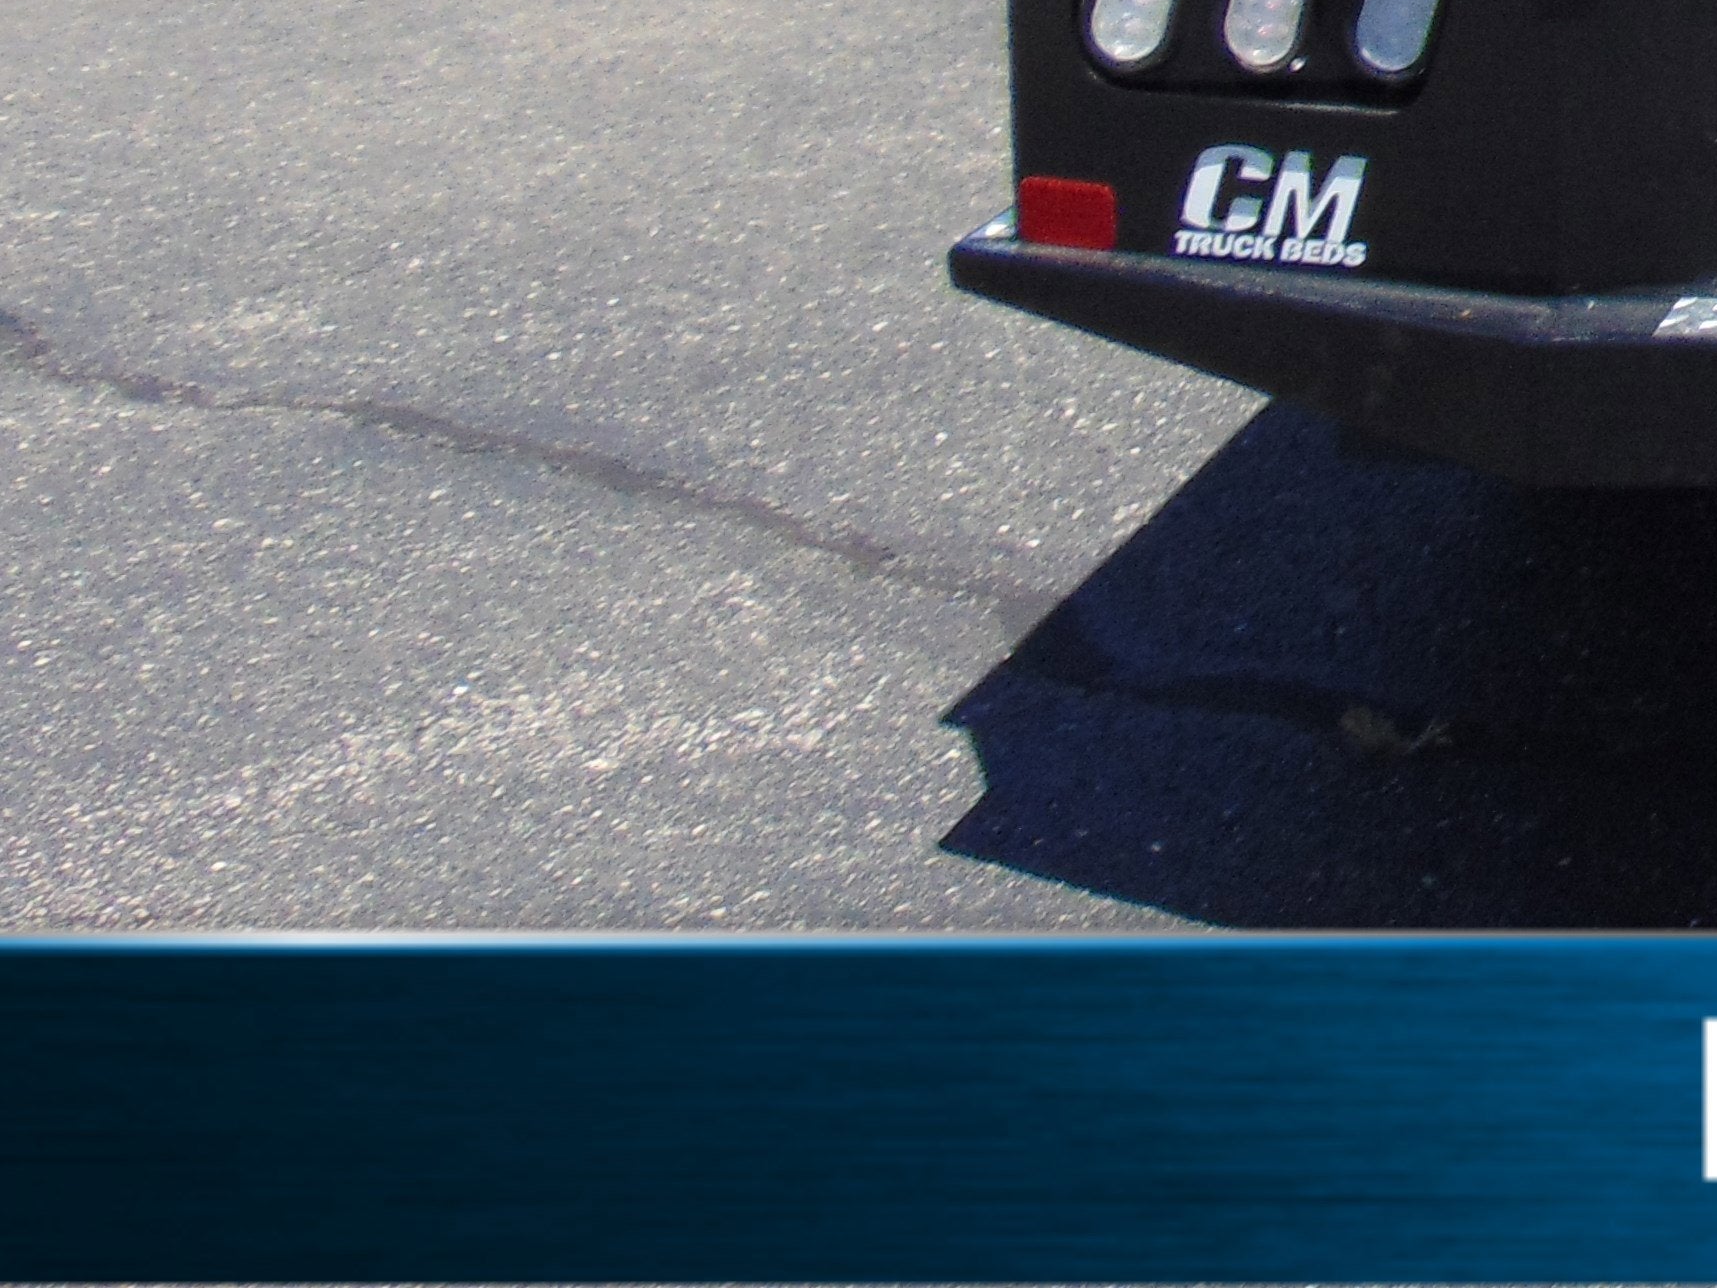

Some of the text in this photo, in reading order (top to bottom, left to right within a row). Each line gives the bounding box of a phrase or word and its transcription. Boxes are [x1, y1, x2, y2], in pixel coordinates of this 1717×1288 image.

[1180, 144, 1369, 240] CM
[1174, 231, 1368, 269] TRUCK BEDS
